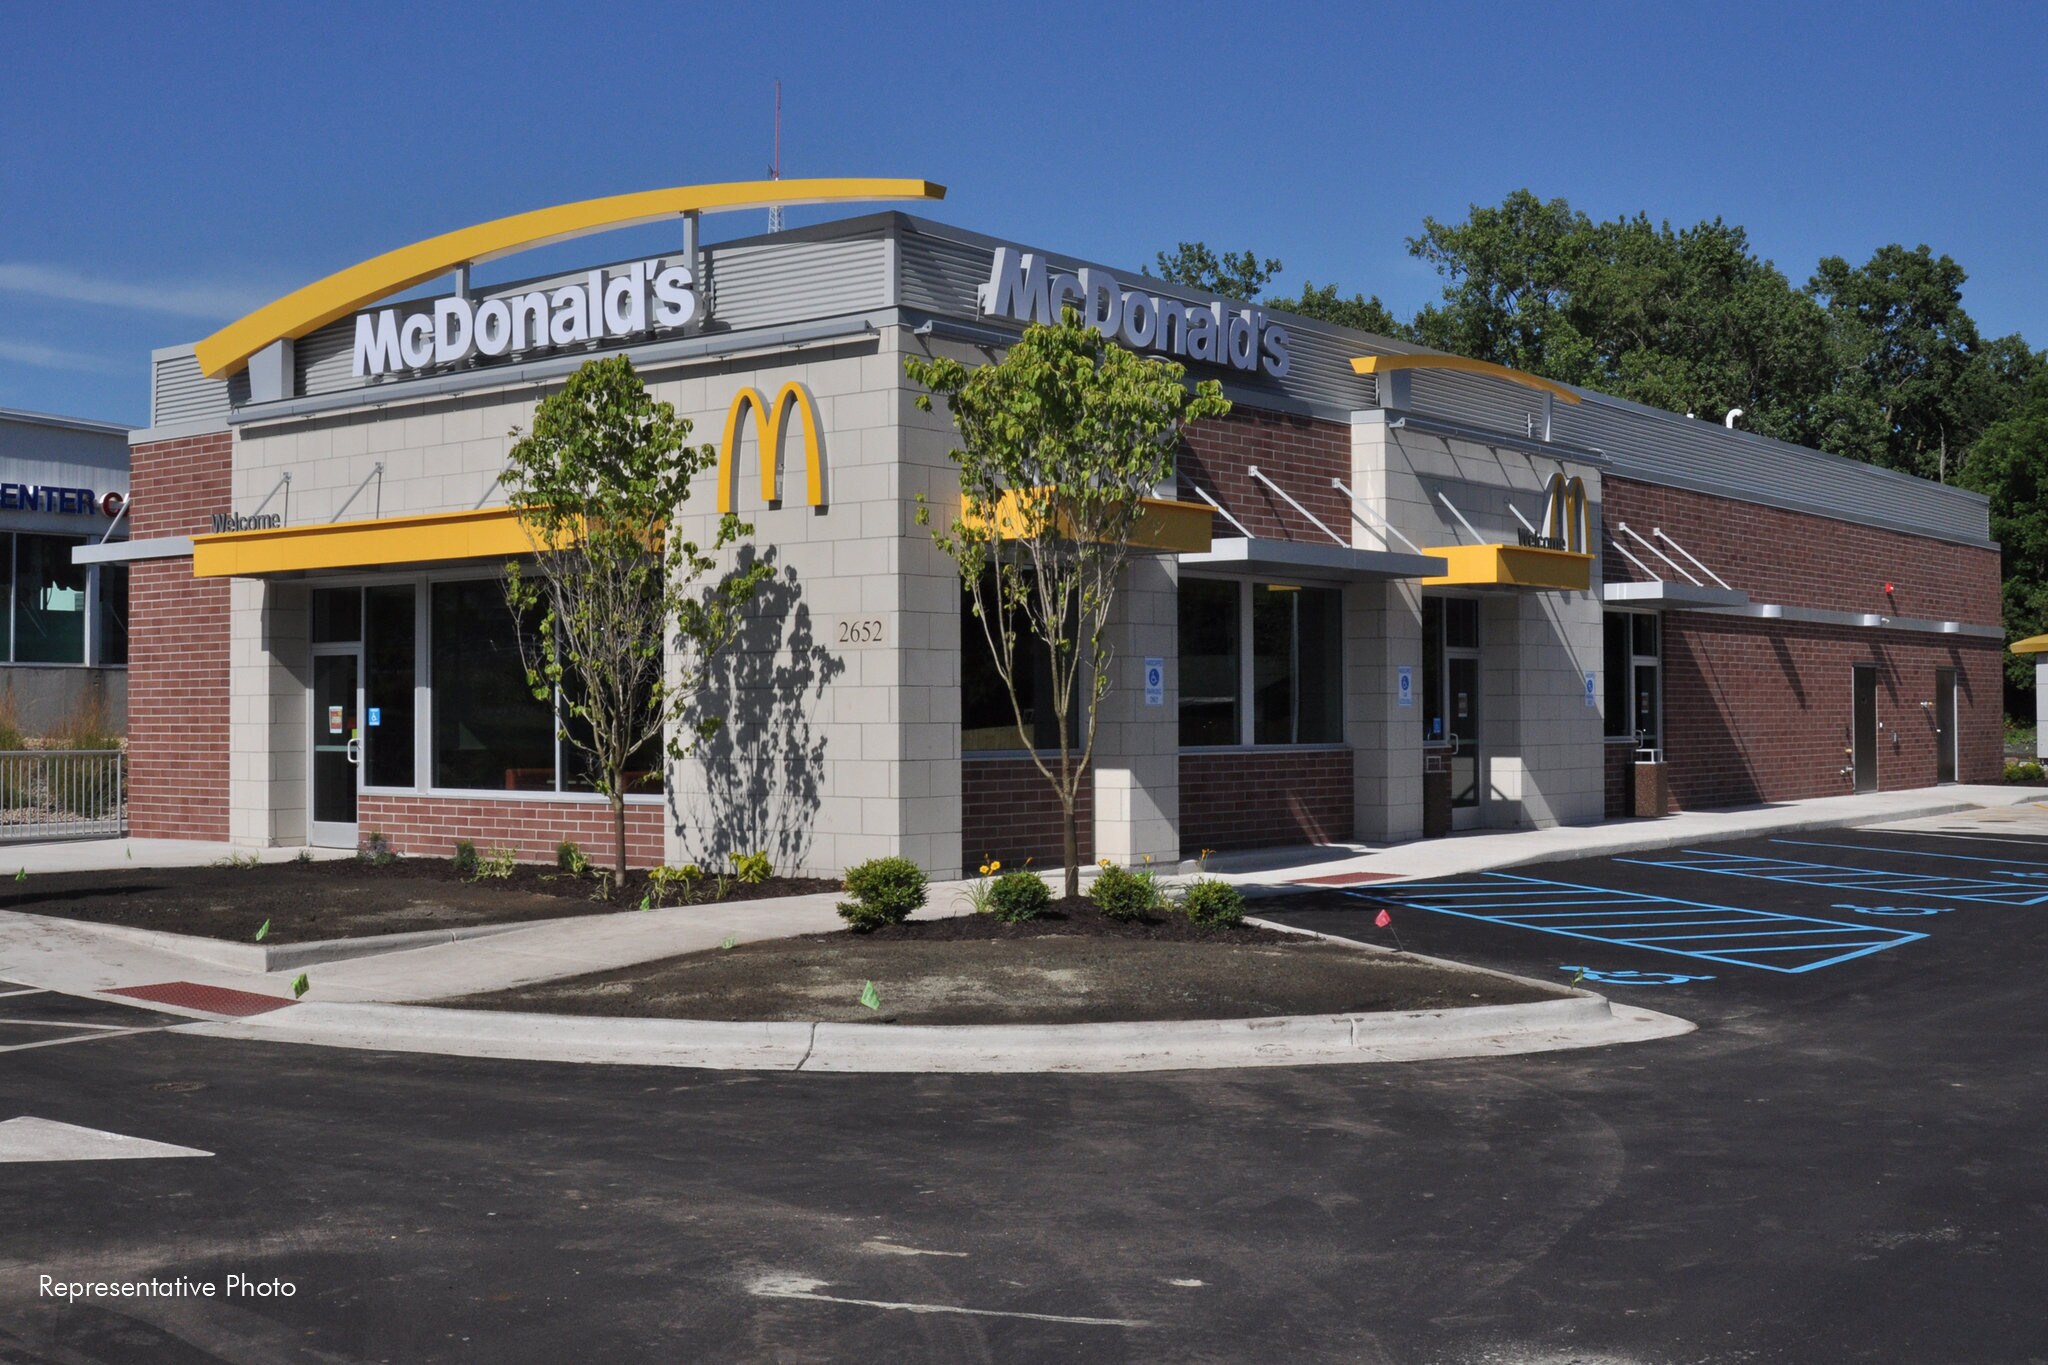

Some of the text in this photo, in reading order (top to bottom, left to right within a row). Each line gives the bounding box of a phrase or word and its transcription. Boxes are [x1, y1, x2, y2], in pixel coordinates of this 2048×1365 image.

[352, 259, 696, 378] McDonald's
[984, 247, 1290, 377] McDonald's
[211, 511, 281, 534] Welcome
[1517, 528, 1567, 552] Welcome
[838, 620, 883, 643] 2652
